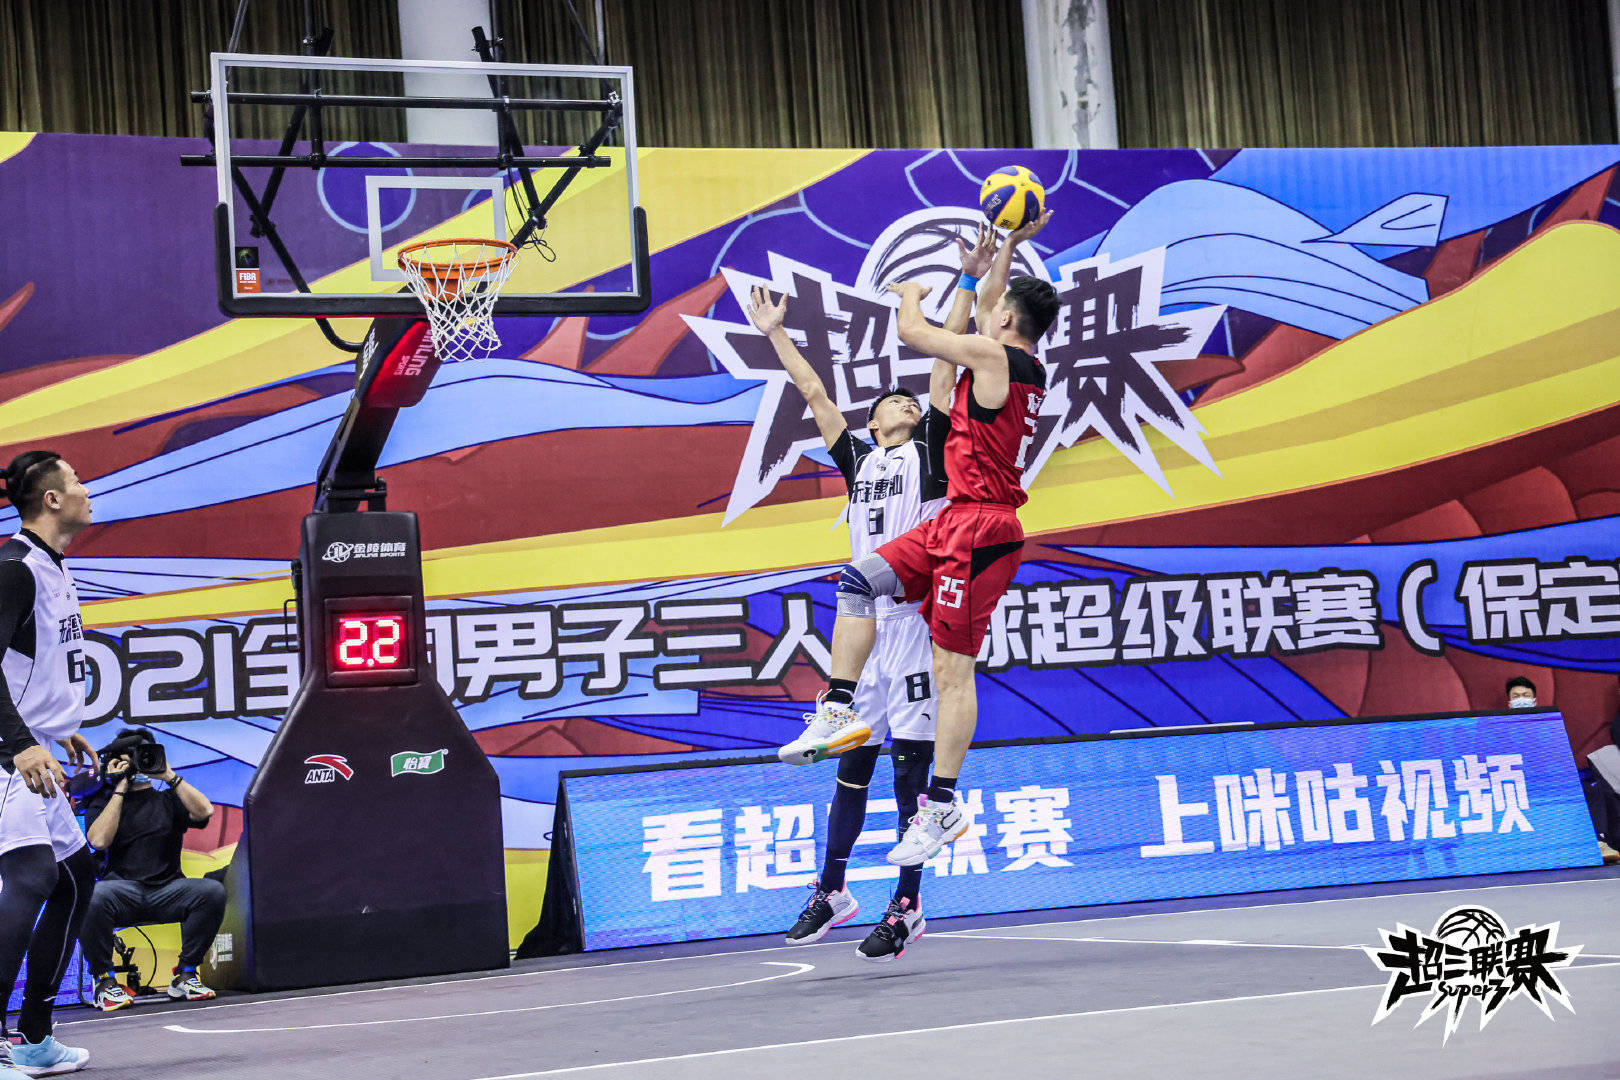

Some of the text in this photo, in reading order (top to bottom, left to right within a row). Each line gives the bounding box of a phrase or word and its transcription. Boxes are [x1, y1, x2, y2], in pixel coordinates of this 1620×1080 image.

[353, 541, 407, 554] 金陵体育
[936, 575, 966, 609] 25
[340, 619, 400, 667] 2.2
[66, 648, 86, 684] 6
[906, 671, 931, 703] 8
[305, 768, 335, 784] ANTA
[1140, 753, 1535, 858] 上咪咕视频
